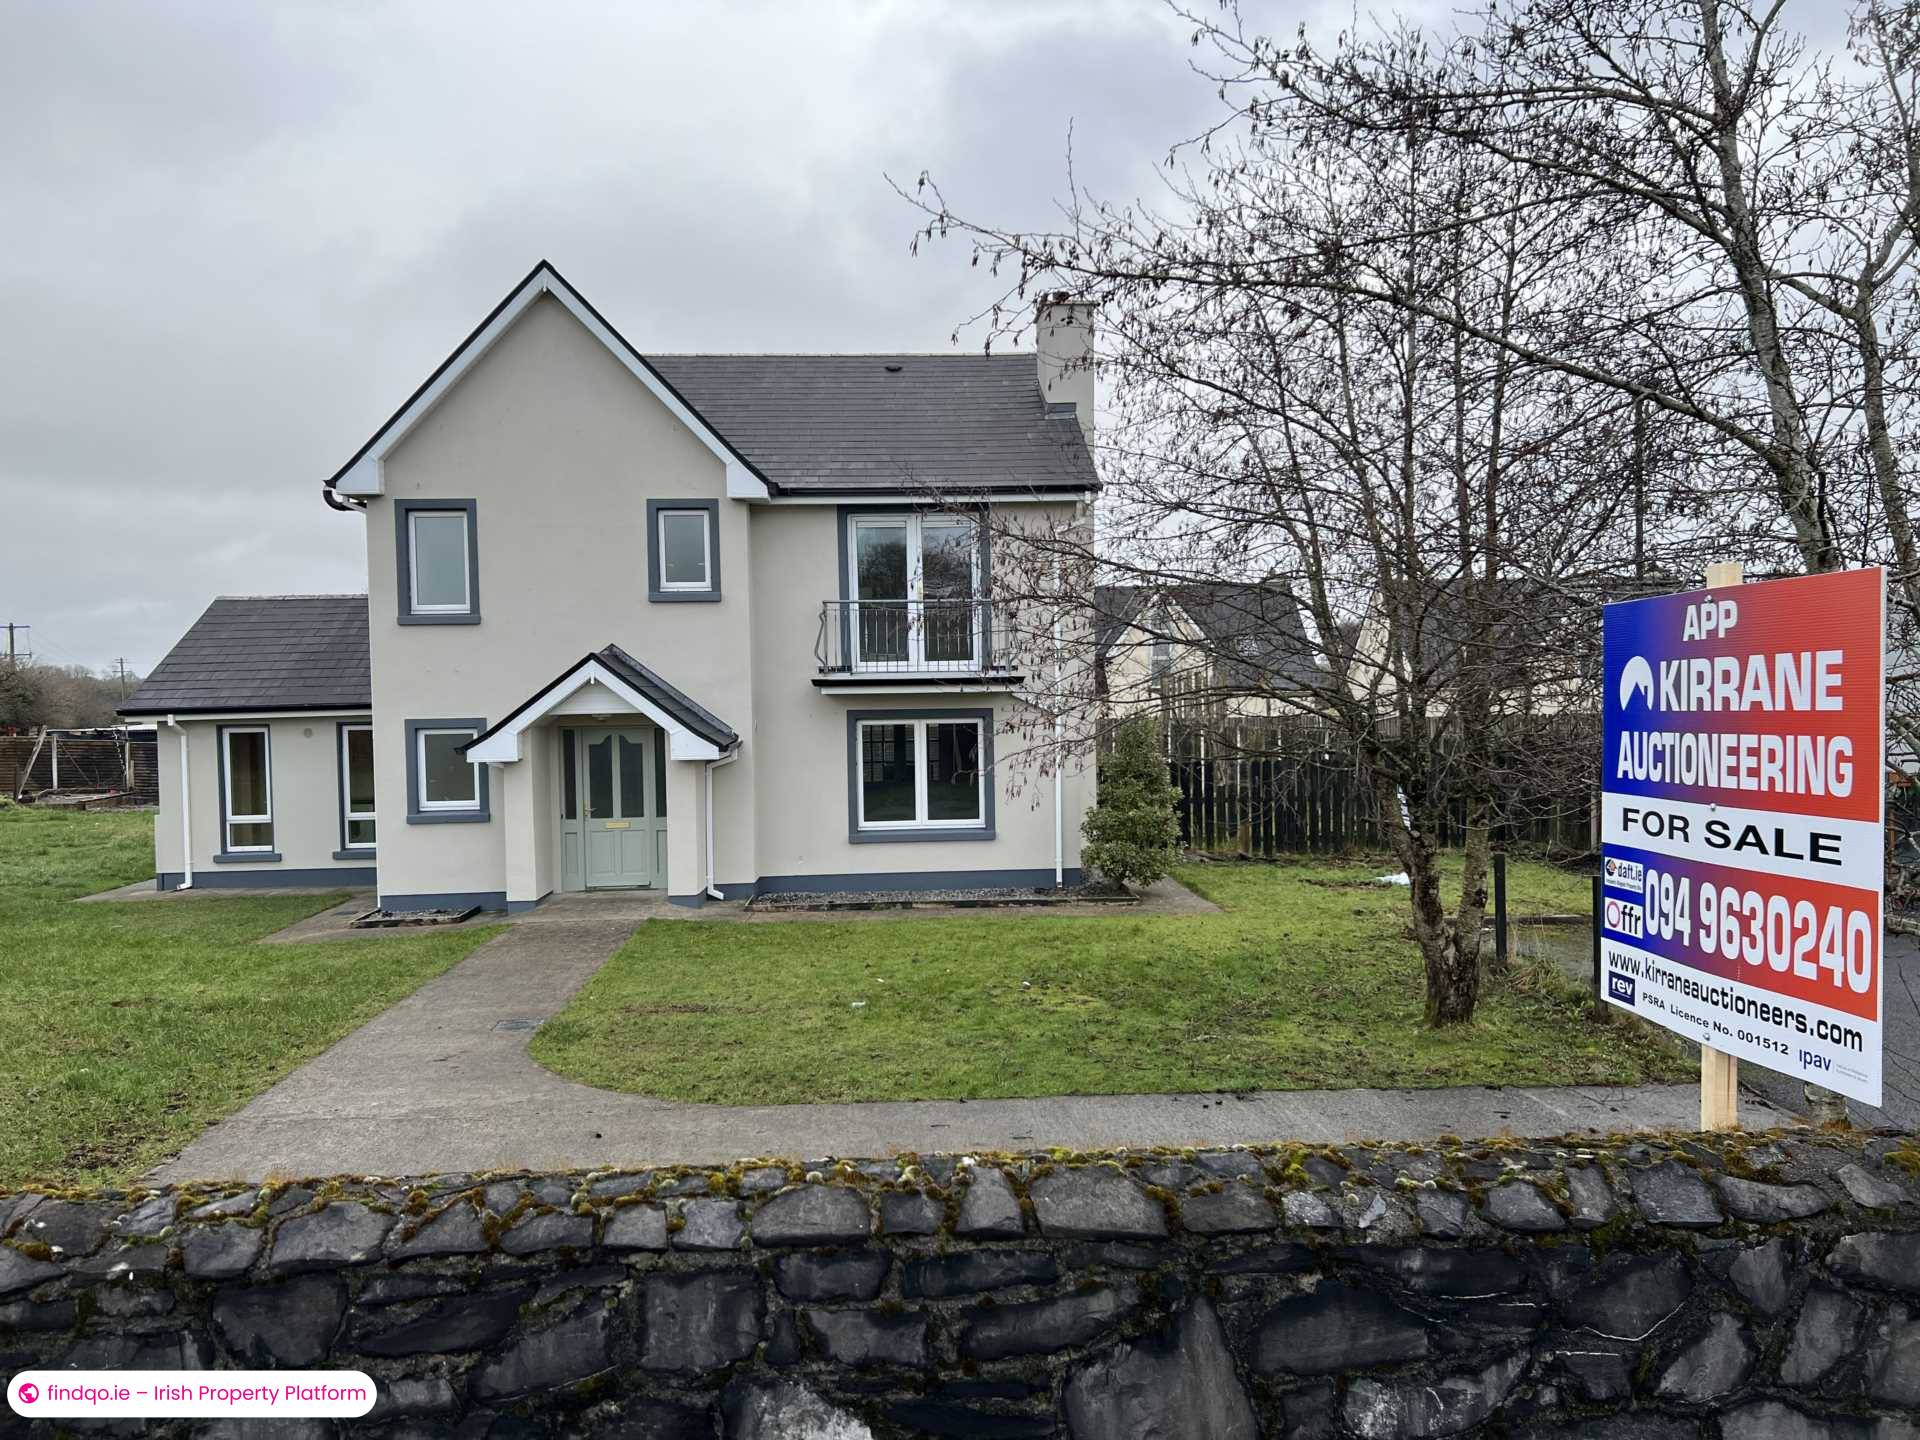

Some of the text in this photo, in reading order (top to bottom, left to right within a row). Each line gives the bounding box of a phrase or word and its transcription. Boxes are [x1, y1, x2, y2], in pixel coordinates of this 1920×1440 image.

[1682, 600, 1738, 642] APP
[1660, 649, 1844, 712] KIRRANE
[1617, 730, 1853, 798] AUCTIONEERING
[1622, 807, 1842, 866] FOR SALE
[1617, 862, 1642, 882] daft.ie
[1645, 869, 1872, 994] 094 9630240
[1608, 950, 1863, 1052] www.kirraneauctioneers.com
[1642, 991, 1789, 1056] PSRA Licence No. 001512
